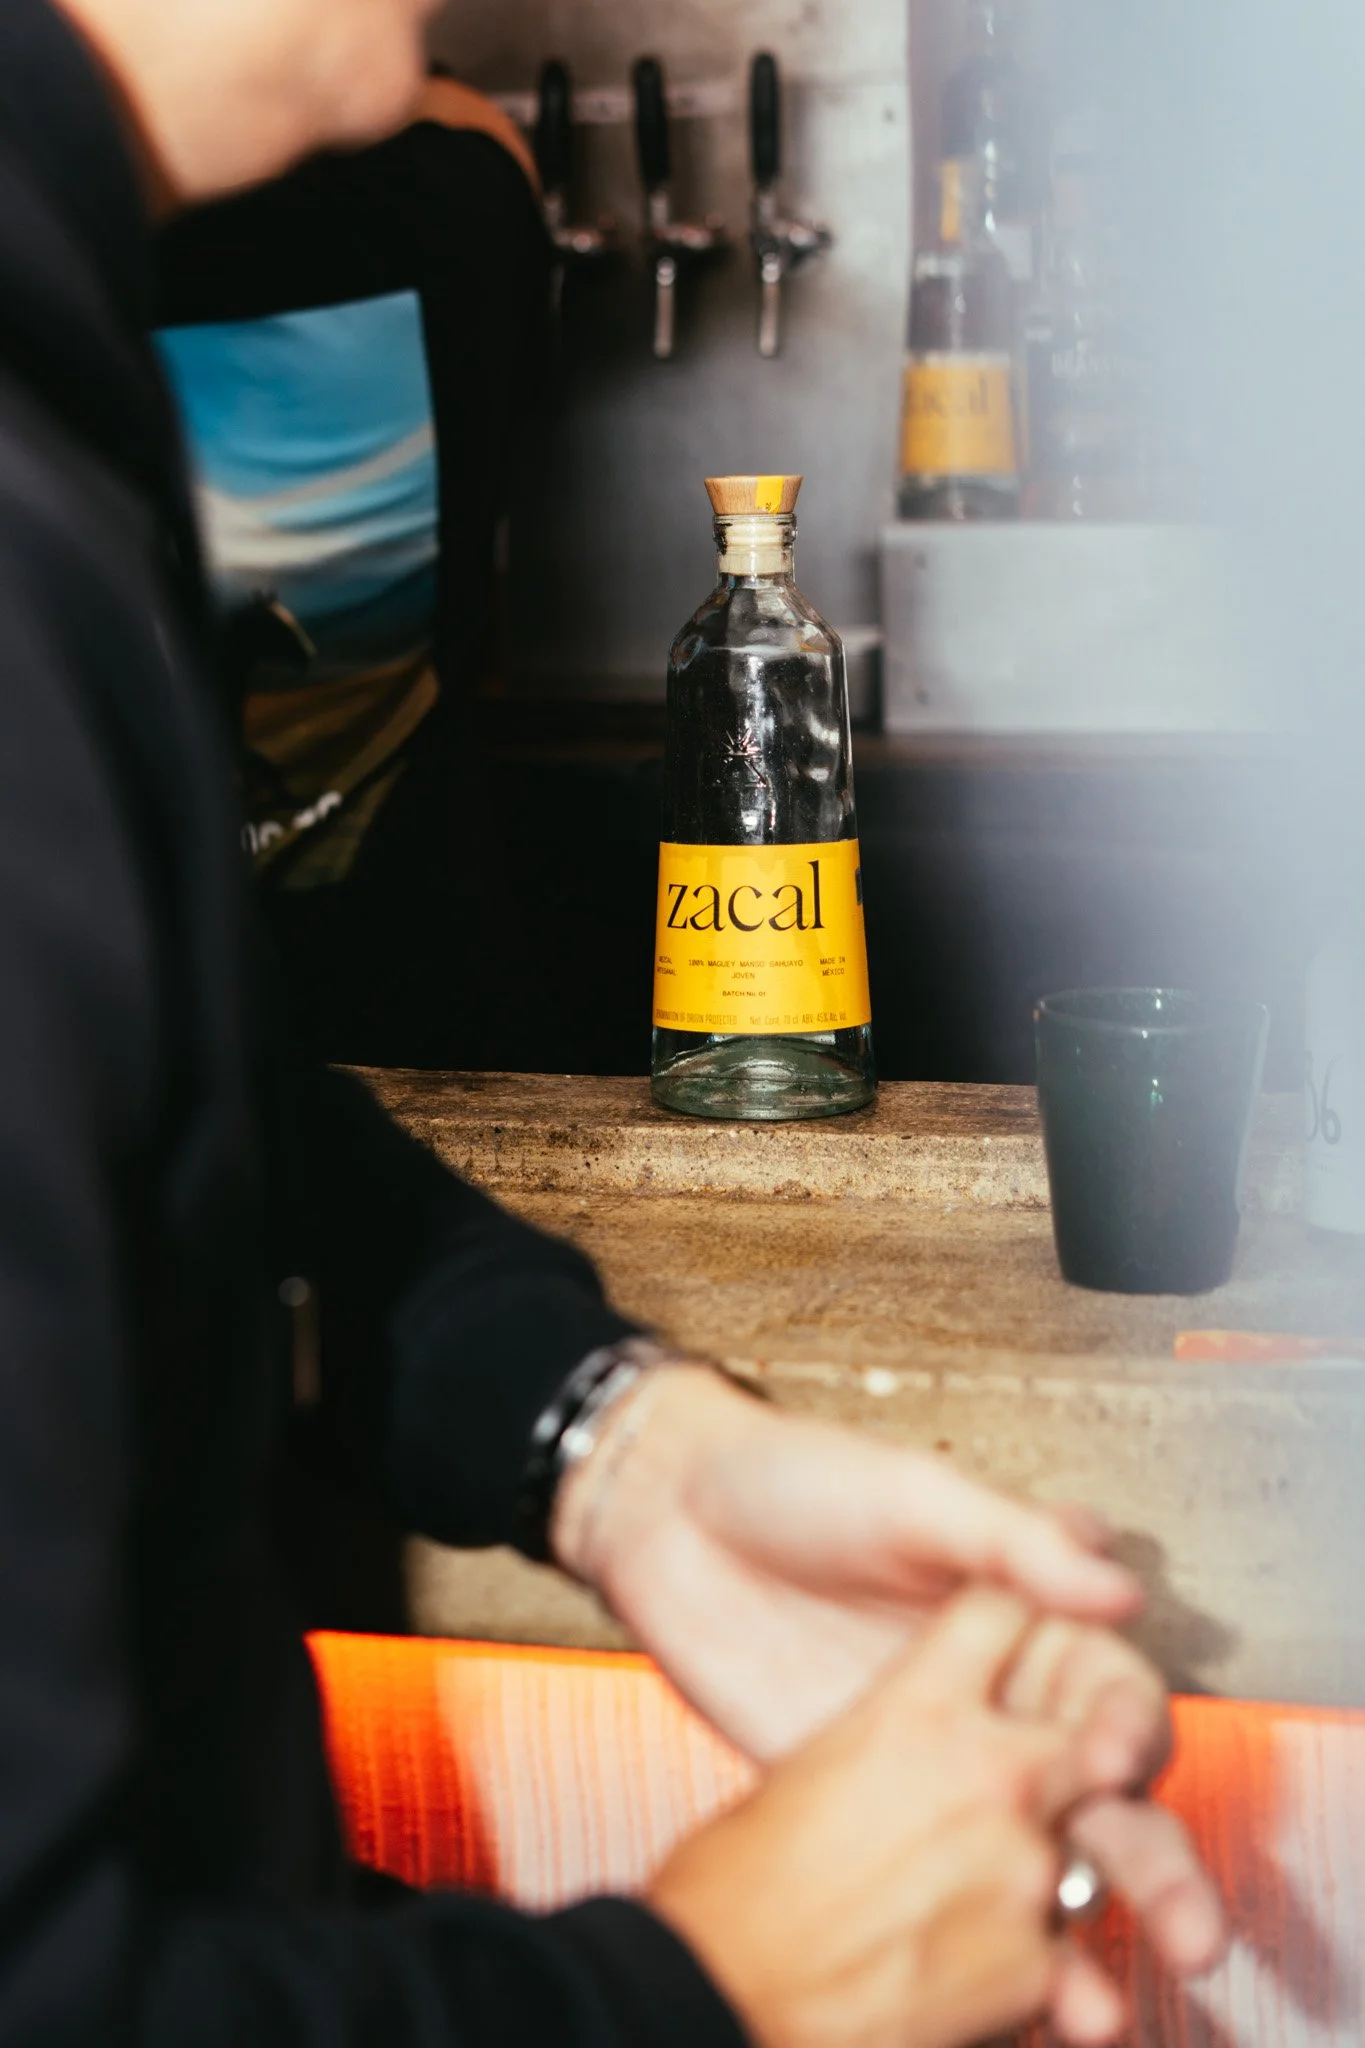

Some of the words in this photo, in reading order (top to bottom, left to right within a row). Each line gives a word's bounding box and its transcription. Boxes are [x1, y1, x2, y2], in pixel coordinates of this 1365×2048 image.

[667, 860, 825, 932] zacal
[708, 960, 736, 968] MAGUEY
[769, 960, 804, 968] SAHUAYO
[820, 957, 835, 965] MADE
[822, 967, 845, 976] MÉXICO
[705, 1014, 737, 1025] PROTECTED
